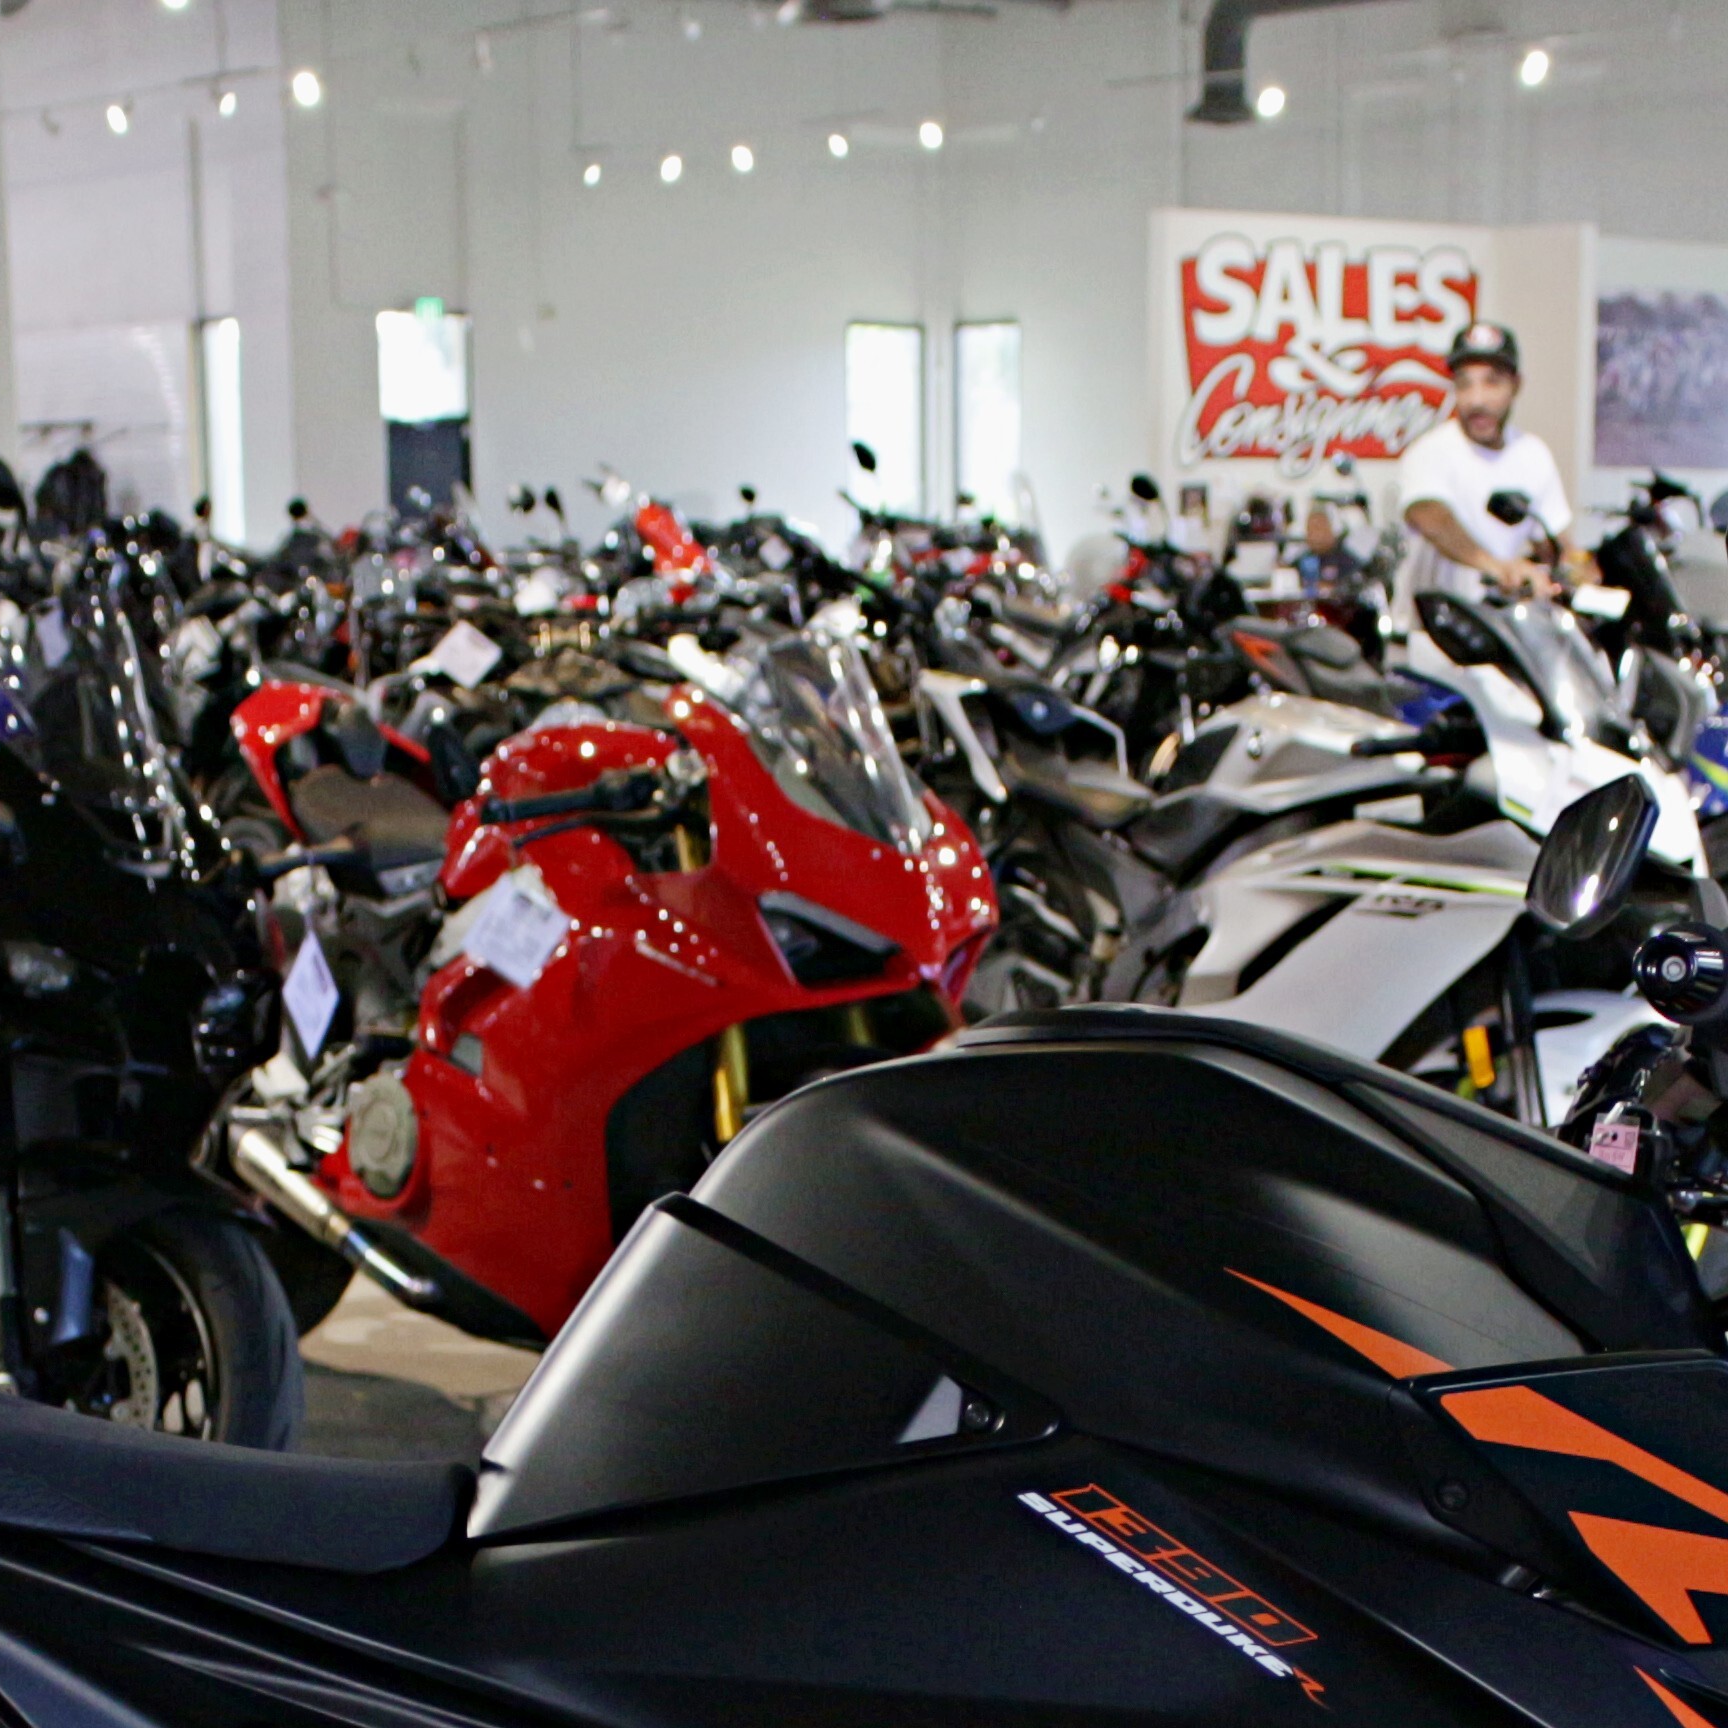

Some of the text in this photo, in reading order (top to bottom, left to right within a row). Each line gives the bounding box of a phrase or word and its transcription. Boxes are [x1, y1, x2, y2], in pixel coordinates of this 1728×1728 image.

[1191, 231, 1474, 355] SALES
[1267, 331, 1378, 397] &
[1049, 1482, 1319, 1647] 1390
